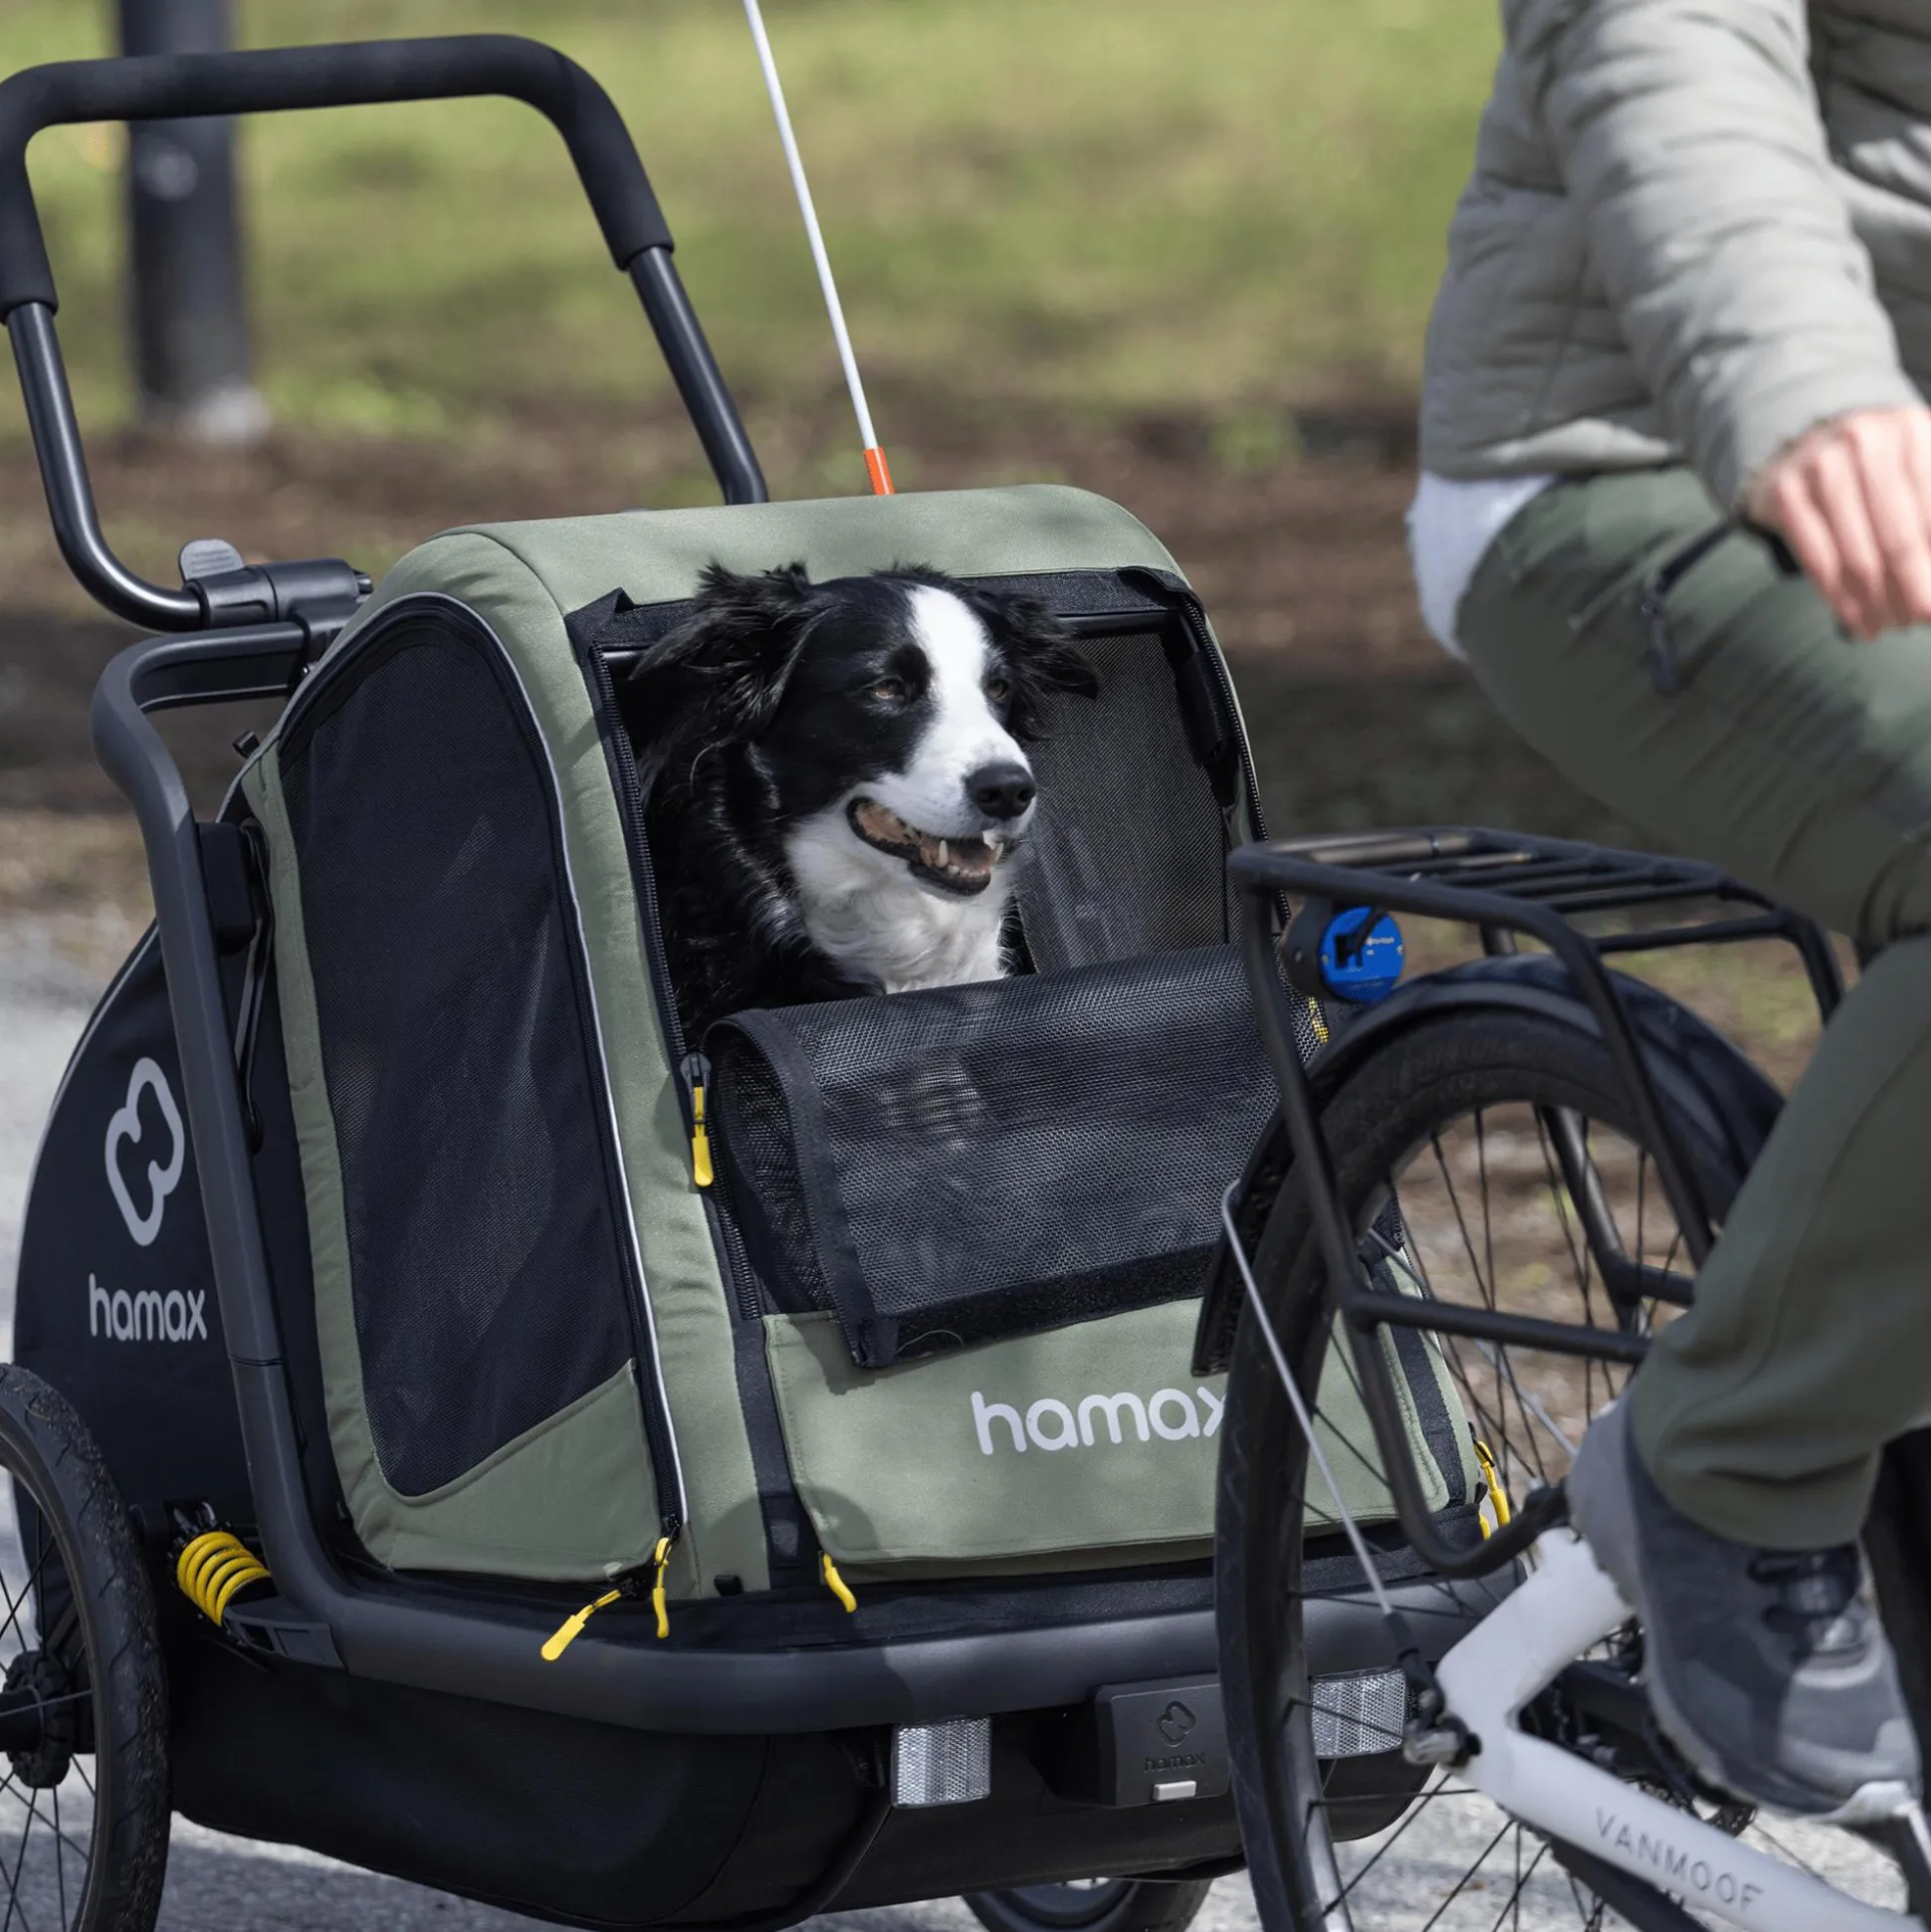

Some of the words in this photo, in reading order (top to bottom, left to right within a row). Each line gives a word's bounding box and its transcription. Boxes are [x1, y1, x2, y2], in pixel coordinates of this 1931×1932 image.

[89, 1273, 208, 1343] hamax
[1144, 1752, 1205, 1773] hamax
[1596, 1808, 1765, 1912] VANMOOF
